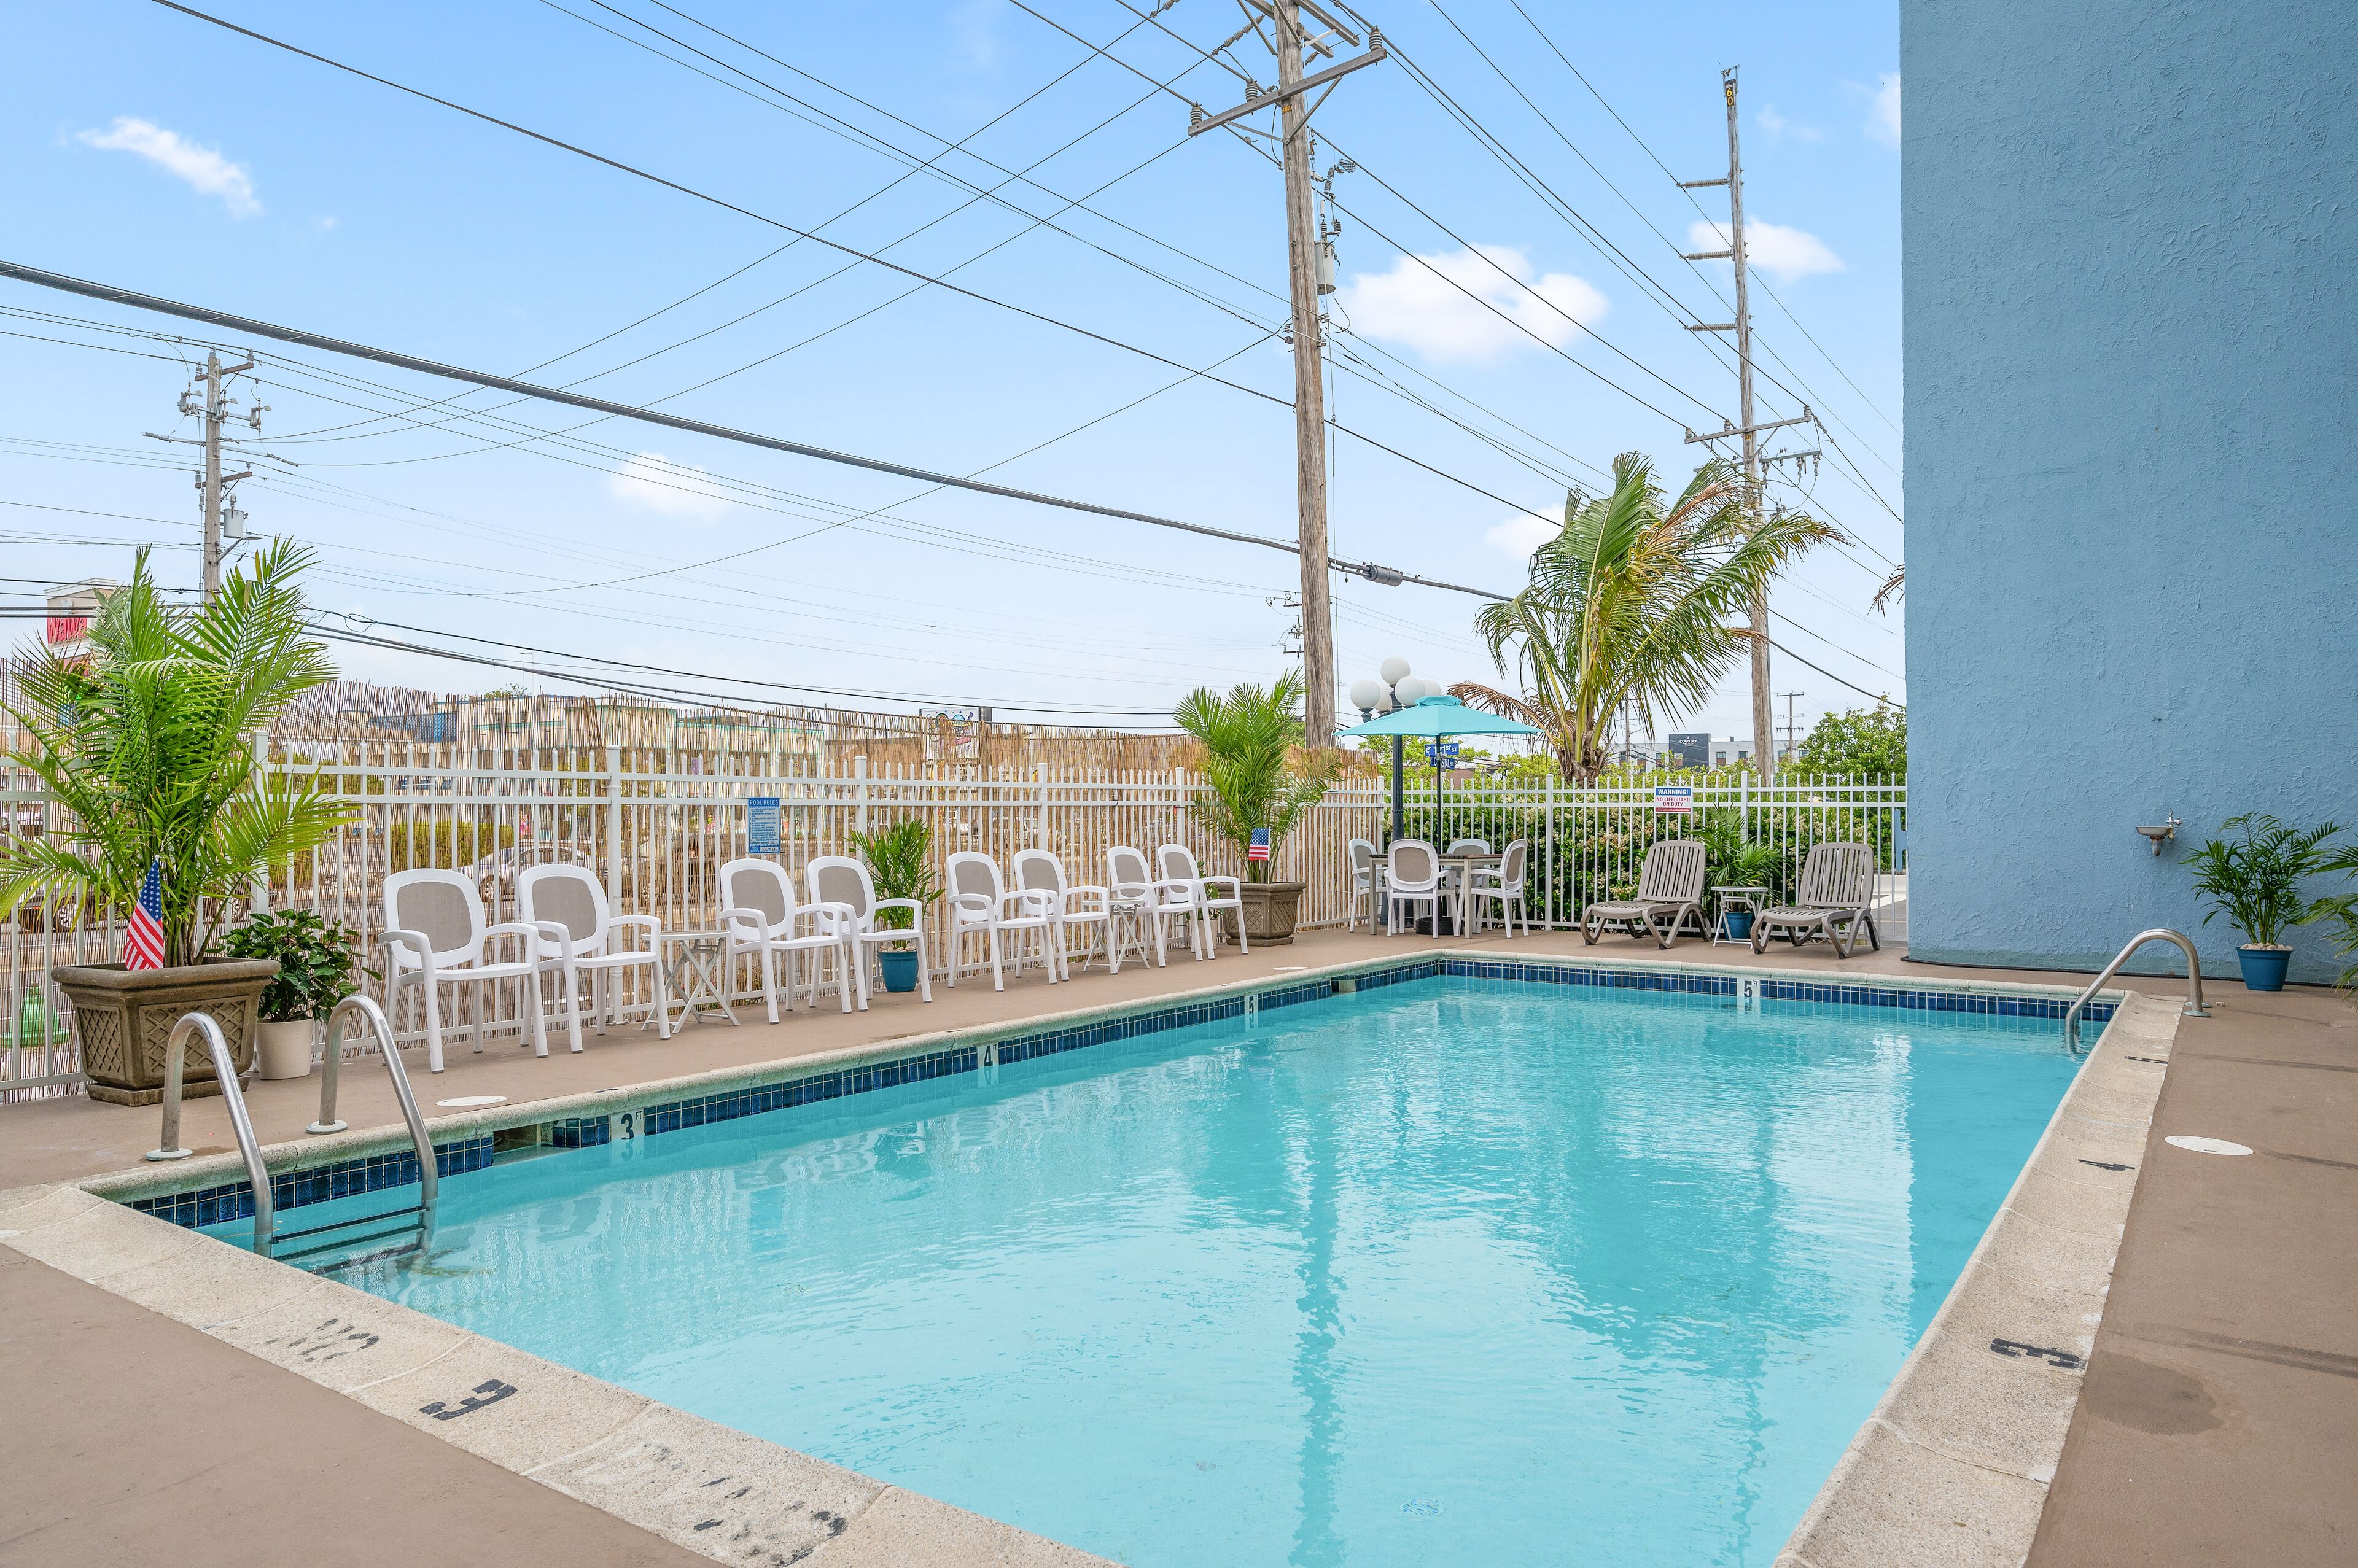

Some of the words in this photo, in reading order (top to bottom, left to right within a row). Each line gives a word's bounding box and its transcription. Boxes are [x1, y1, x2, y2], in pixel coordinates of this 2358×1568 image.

[1726, 88, 1733, 106] 60
[1433, 756, 1450, 768] CSTAL
[1744, 980, 1753, 998] 5
[1248, 996, 1254, 1014] 5
[984, 1045, 993, 1067] 4
[621, 1113, 634, 1140] 3
[636, 1111, 642, 1120] FT
